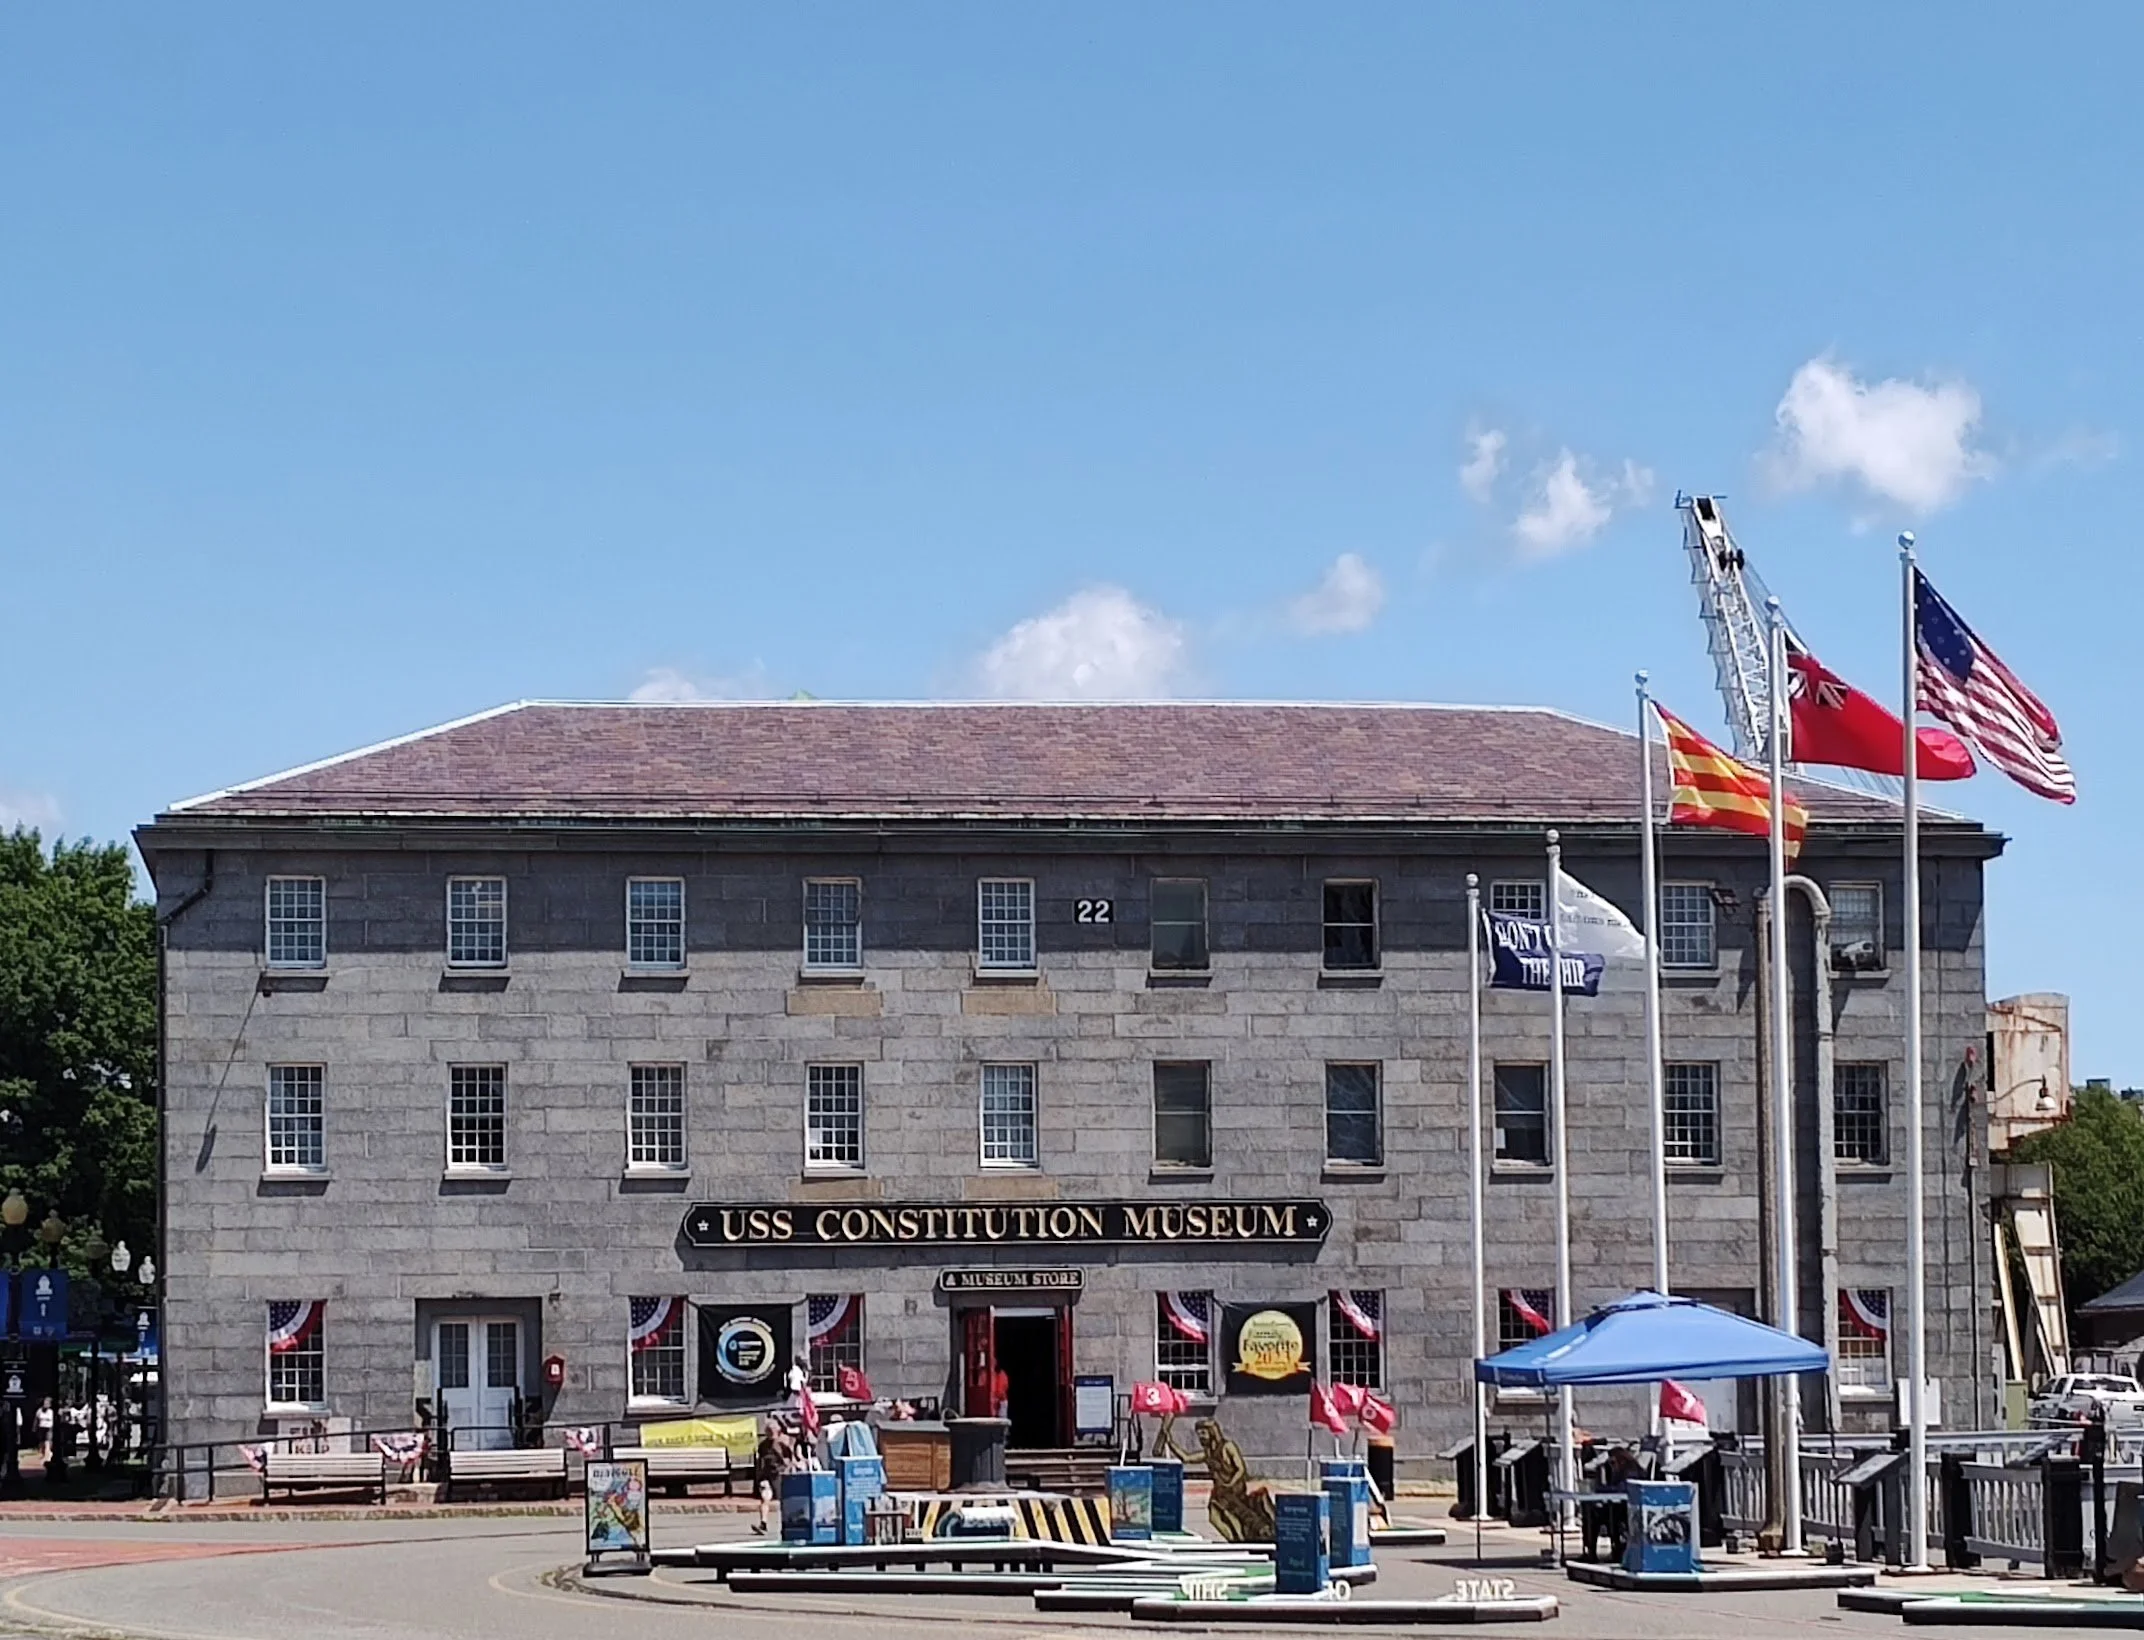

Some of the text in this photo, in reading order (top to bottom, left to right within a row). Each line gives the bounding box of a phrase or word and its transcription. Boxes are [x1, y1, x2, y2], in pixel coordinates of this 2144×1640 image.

[1078, 900, 1110, 923] 22
[1519, 957, 1551, 986] THE
[720, 1205, 1298, 1241] USS CONSTITUTION MUSEUM
[961, 1271, 1079, 1287] MUSEUM STORE
[1145, 1387, 1161, 1406] 3
